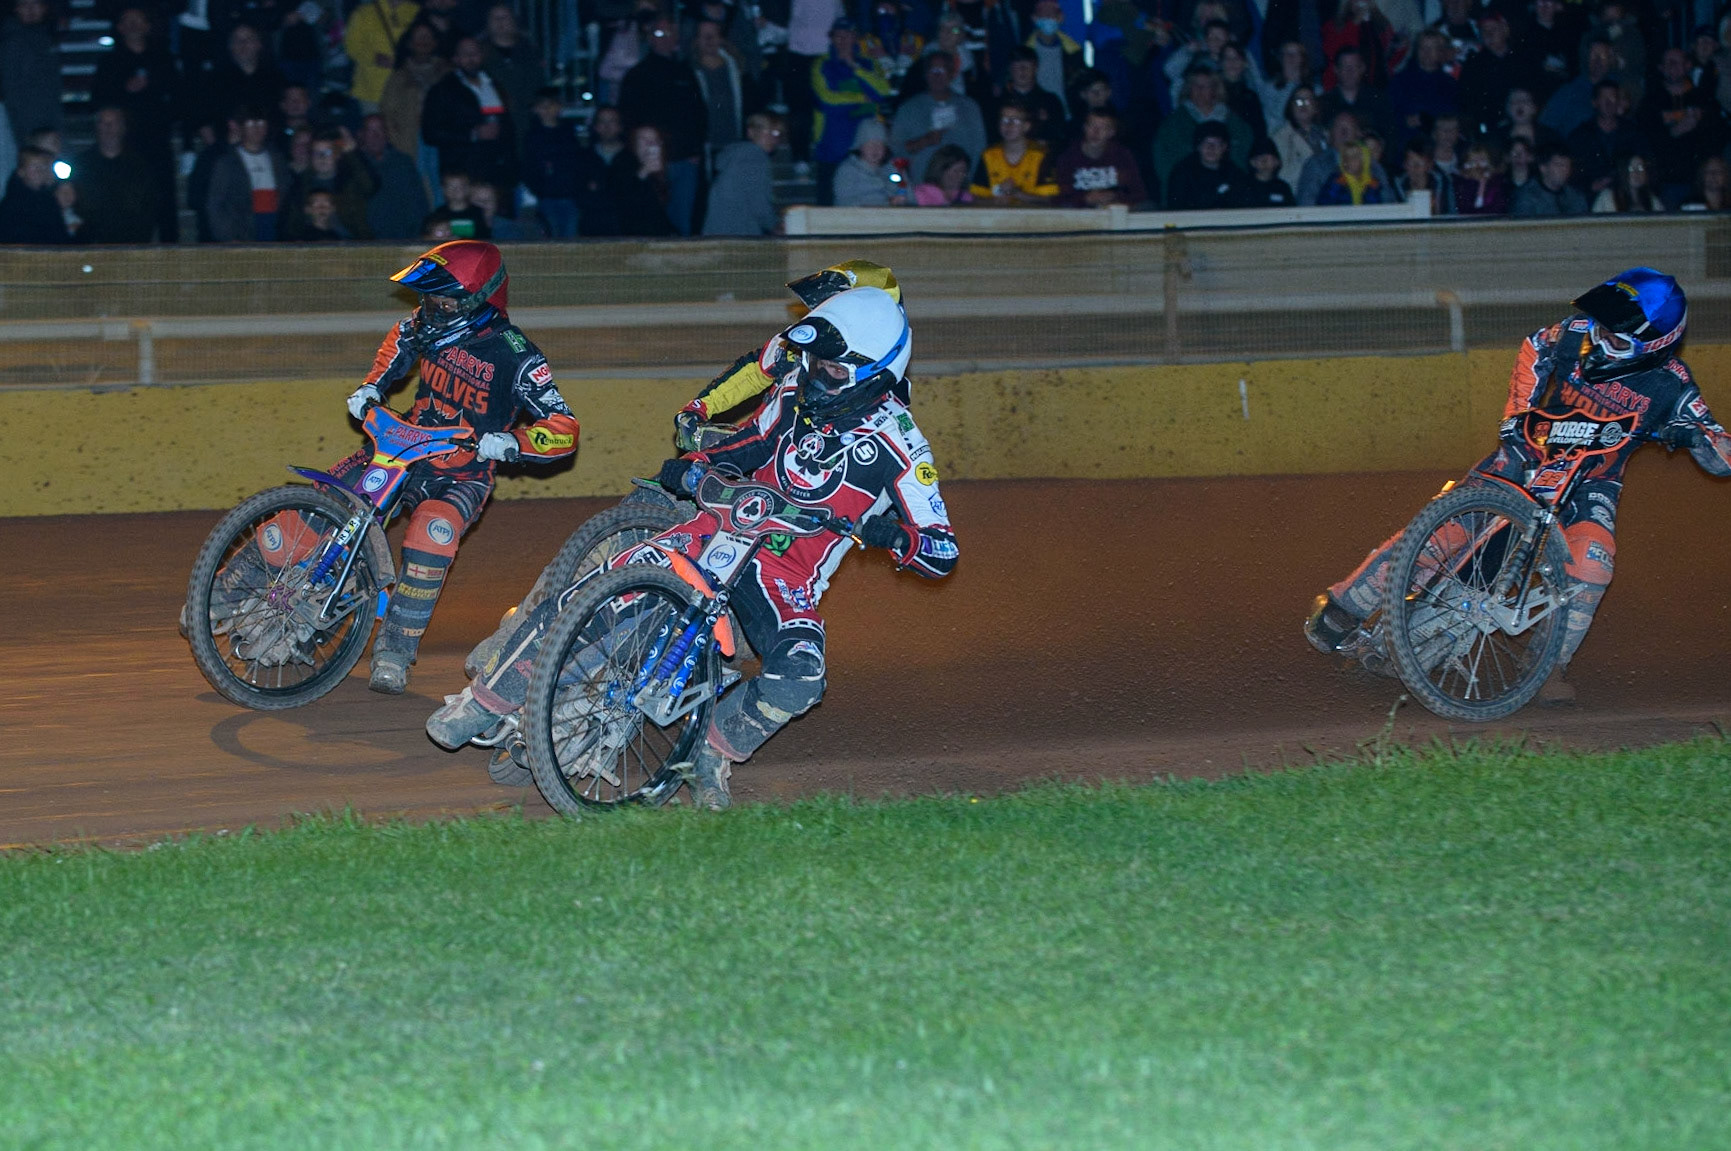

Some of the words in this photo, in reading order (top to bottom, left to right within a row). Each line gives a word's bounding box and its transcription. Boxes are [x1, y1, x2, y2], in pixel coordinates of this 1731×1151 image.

[420, 358, 489, 414] WOLVES
[432, 523, 451, 537] ATPI
[710, 549, 732, 564] ATPI
